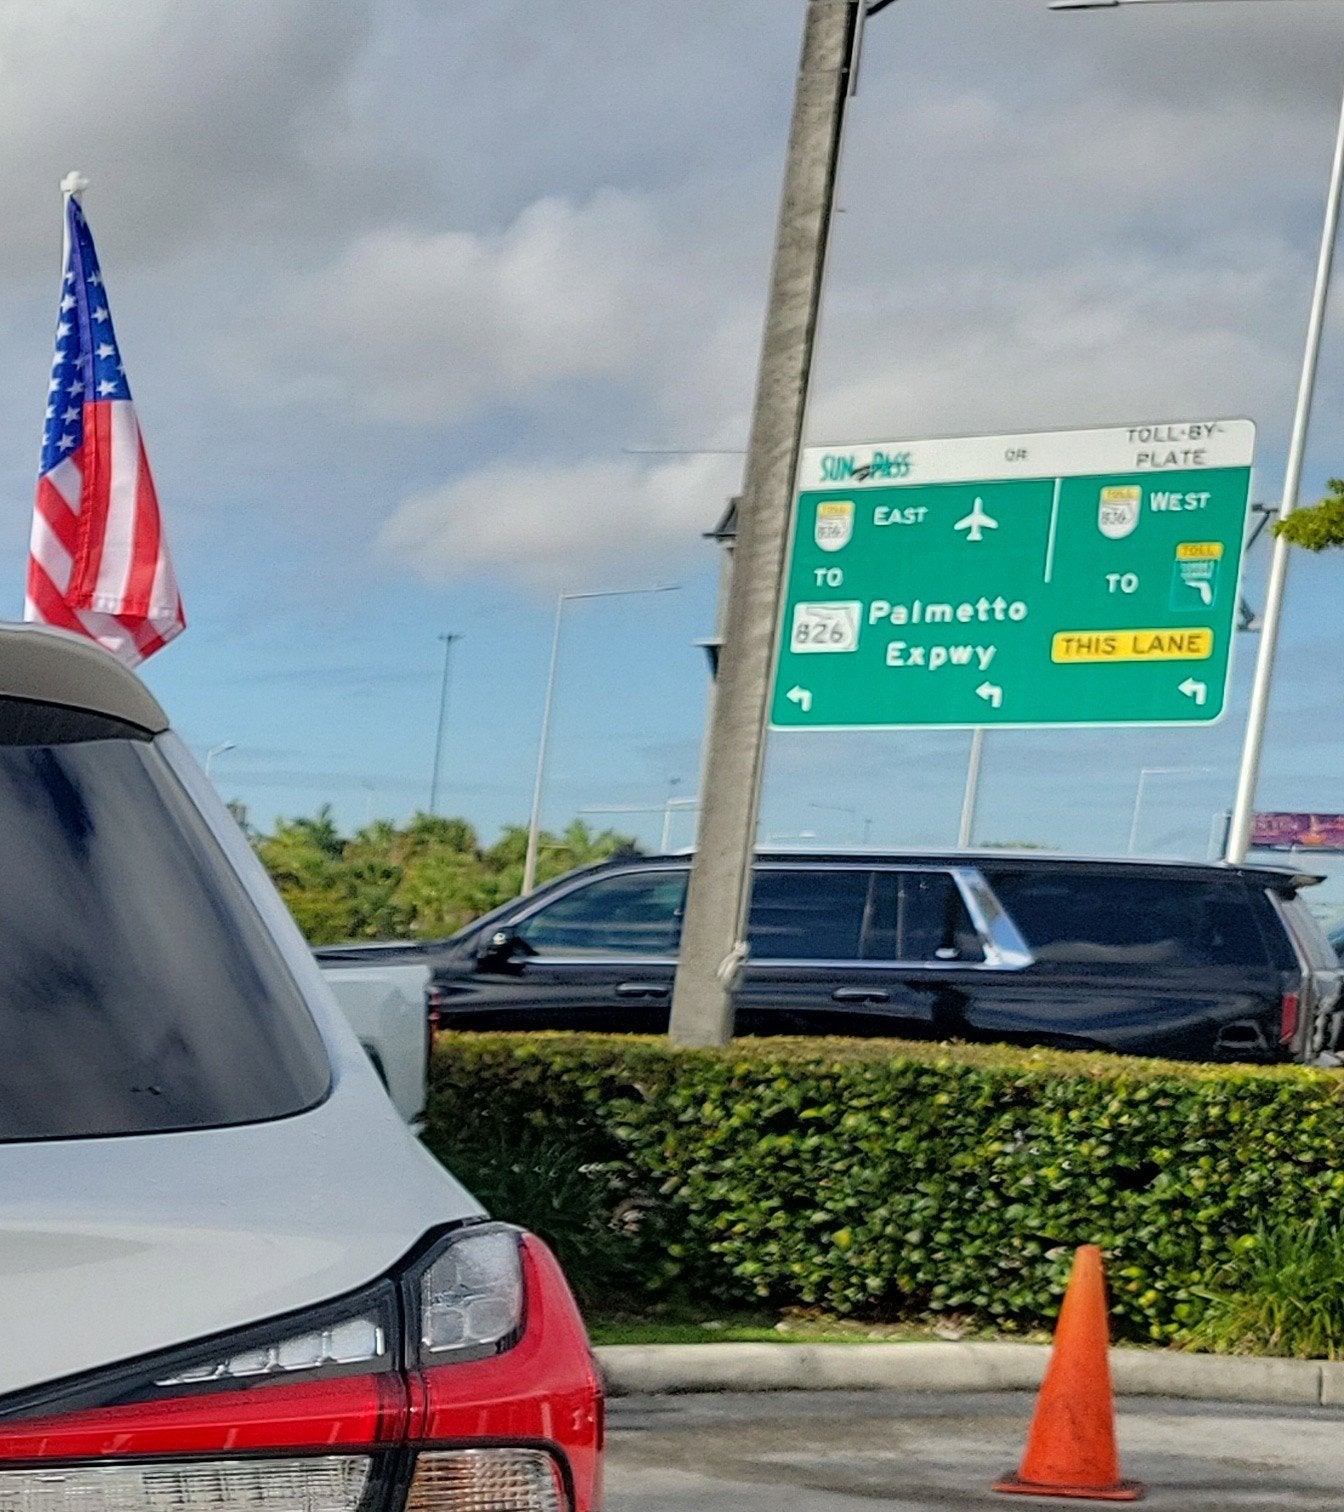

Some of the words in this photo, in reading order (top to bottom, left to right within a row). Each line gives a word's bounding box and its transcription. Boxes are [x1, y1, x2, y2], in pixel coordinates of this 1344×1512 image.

[1136, 448, 1208, 468] PLATE
[1150, 492, 1212, 512] WEST
[873, 506, 929, 525] EAST
[1181, 545, 1215, 557] TOLL
[814, 567, 844, 587] TO
[1105, 572, 1139, 594] TO
[868, 596, 1029, 625] Palmetto
[796, 623, 844, 644] 826
[1062, 637, 1117, 656] THIS
[1131, 633, 1202, 654] LANE
[885, 641, 998, 671] Expwy
